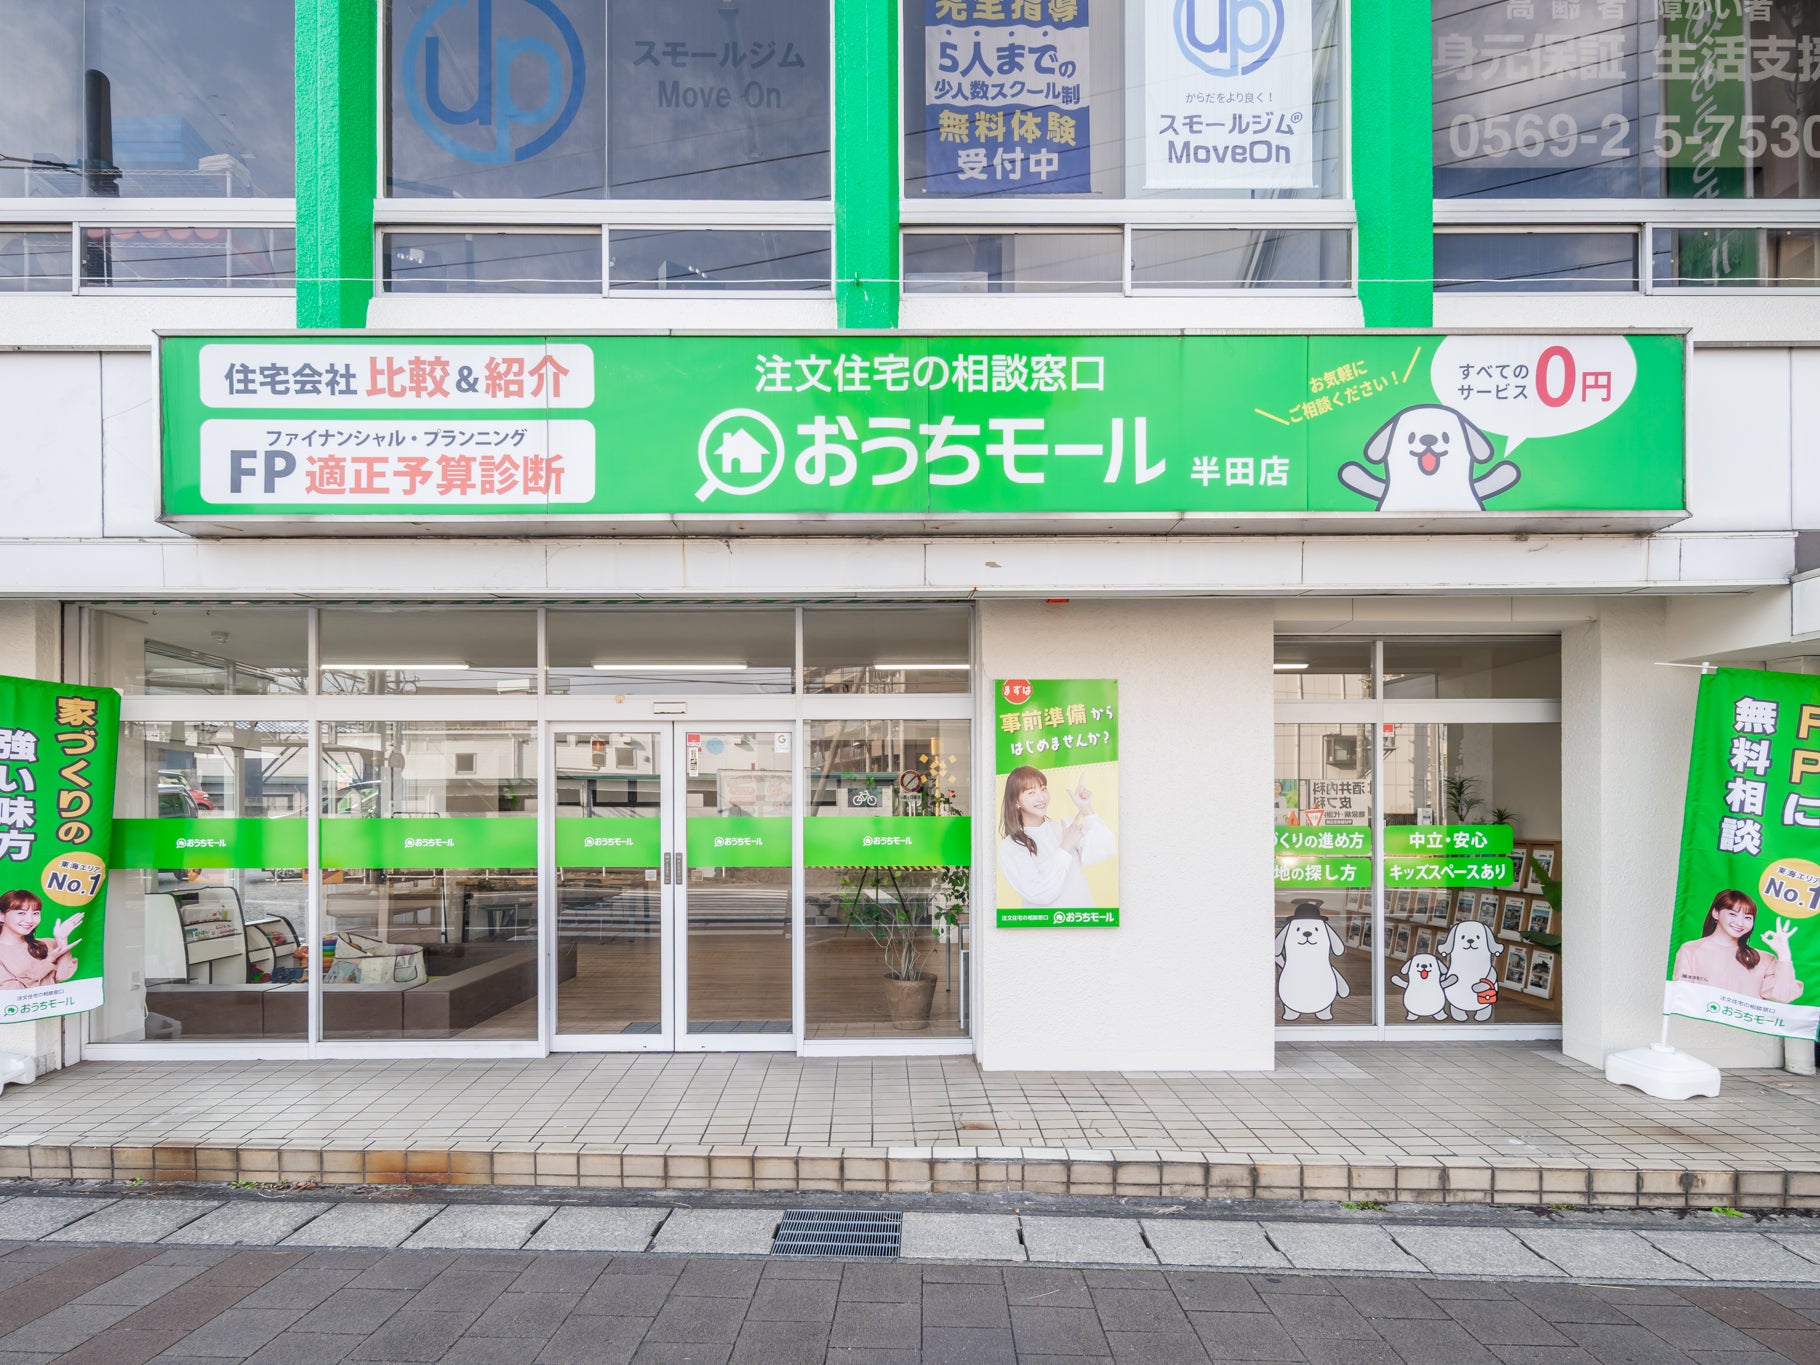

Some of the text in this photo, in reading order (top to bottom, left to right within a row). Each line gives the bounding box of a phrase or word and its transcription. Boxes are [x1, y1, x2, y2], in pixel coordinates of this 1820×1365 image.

[633, 41, 806, 69] スモールジム
[938, 40, 1077, 79] 5人までの
[1433, 33, 1627, 81] 身元保証
[657, 80, 782, 109] Move On
[934, 79, 1080, 105] 少人数スクール制
[1185, 92, 1273, 104] からだをより良く！
[939, 109, 1077, 146] 無料体験
[1167, 140, 1291, 164] MoveOn
[957, 148, 1059, 181] 受付中
[224, 362, 358, 396] 住宅会社
[755, 353, 1106, 392] 注文住宅の相談窓口
[1309, 360, 1368, 393] お気軽に
[1459, 363, 1529, 380] すべての
[1289, 371, 1399, 422] ご相談ください！
[1457, 383, 1529, 400] サービス
[266, 429, 527, 448] ファイナンシャル・プランニング
[795, 415, 1166, 486] おうちモール
[1191, 456, 1289, 487] 半田店
[1003, 685, 1031, 696] まずは
[1011, 731, 1110, 756] はじめませんか？
[56, 697, 98, 844] 家づくりの
[1718, 697, 1778, 857] 無料相談
[0, 728, 38, 861] 強い味方
[187, 838, 226, 847] おうちモール
[415, 838, 454, 847] おうちモール
[595, 837, 634, 846] おうちモール
[725, 837, 763, 846] おうちモール
[874, 837, 912, 845] おうちモール
[1409, 831, 1488, 848] 中立・安心
[60, 861, 100, 872] 東海エリア
[1390, 864, 1506, 880] キッズスペースあり
[47, 872, 101, 896] No.1
[1066, 912, 1114, 922] おうちモール
[20, 997, 75, 1014] おうちモール
[1722, 1006, 1785, 1026] おうちモール
